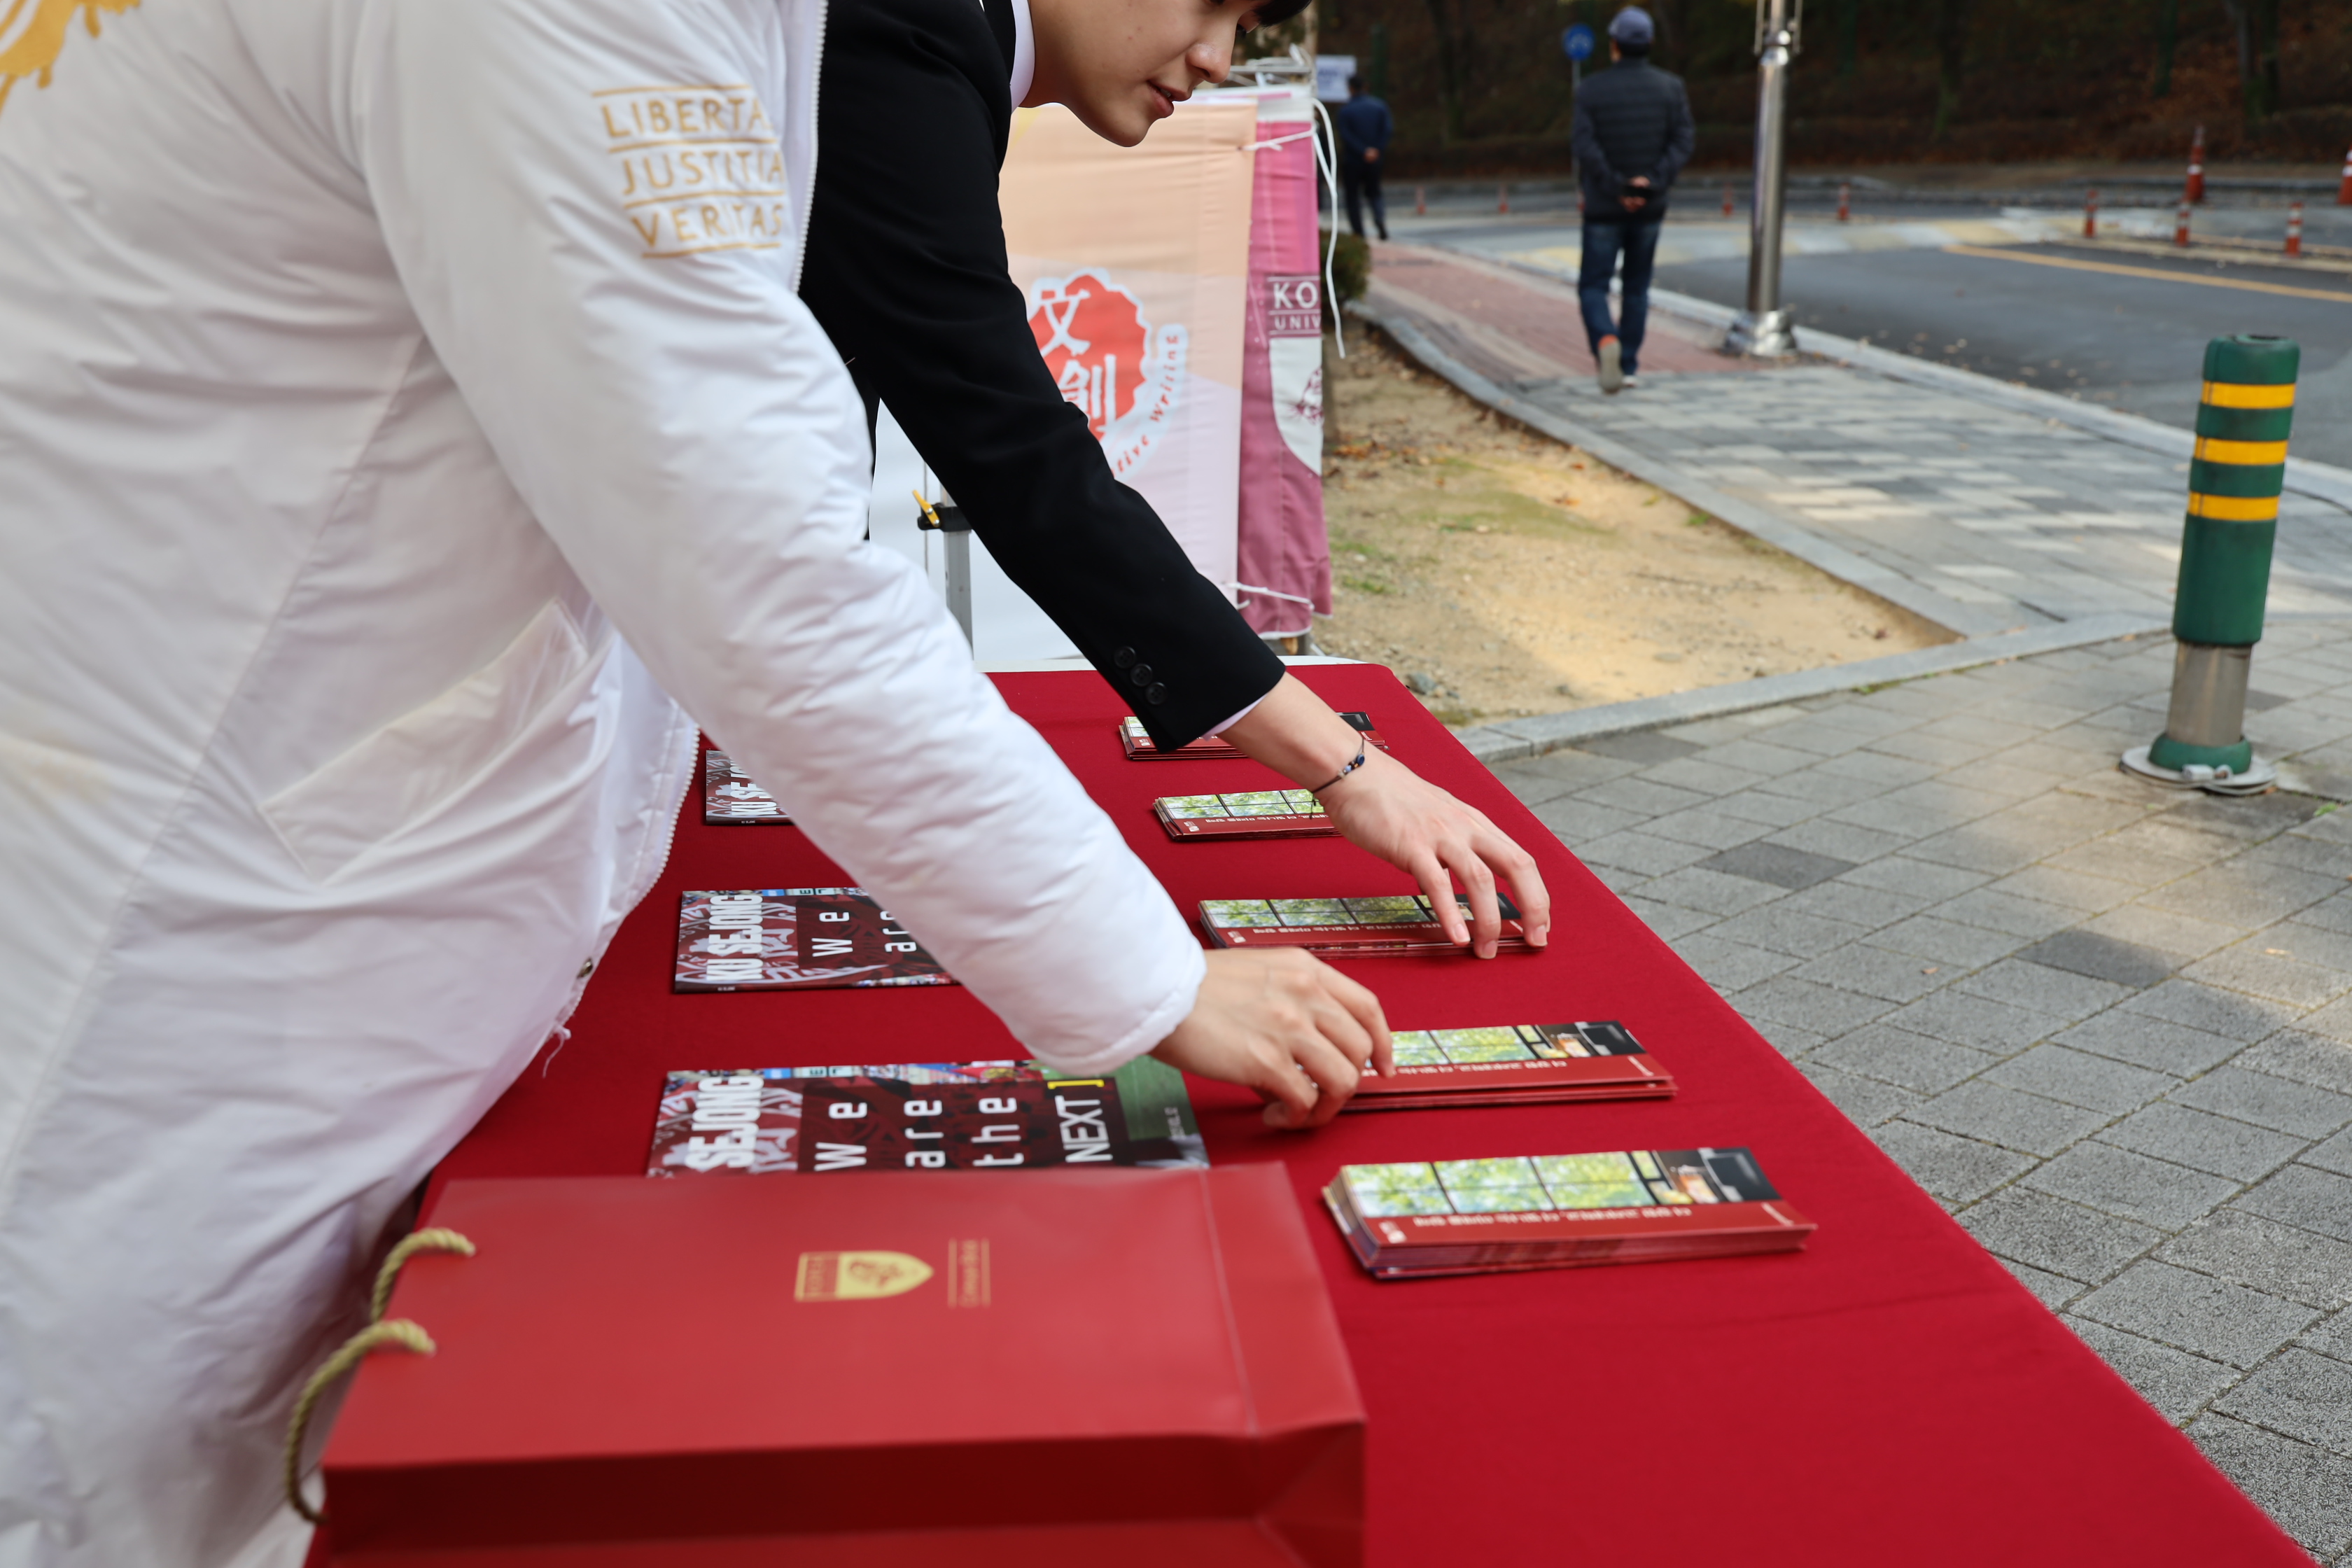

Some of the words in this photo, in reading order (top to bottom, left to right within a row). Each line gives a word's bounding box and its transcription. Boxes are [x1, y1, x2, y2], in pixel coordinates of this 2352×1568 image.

[622, 150, 785, 196] JUSTITIA
[631, 204, 784, 248] VERITAS
[1273, 281, 1319, 309] KO
[1274, 314, 1322, 330] UNIV
[1112, 434, 1149, 477] tive
[1149, 335, 1180, 423] Writing
[730, 801, 777, 816] KU
[706, 895, 763, 955] SEJONG
[811, 911, 853, 958] We
[706, 958, 764, 980] KU
[684, 1076, 764, 1168] SEJONG
[814, 1102, 868, 1171] We
[904, 1100, 946, 1168] are
[971, 1097, 1025, 1167] the
[1054, 1095, 1113, 1163] NEXT
